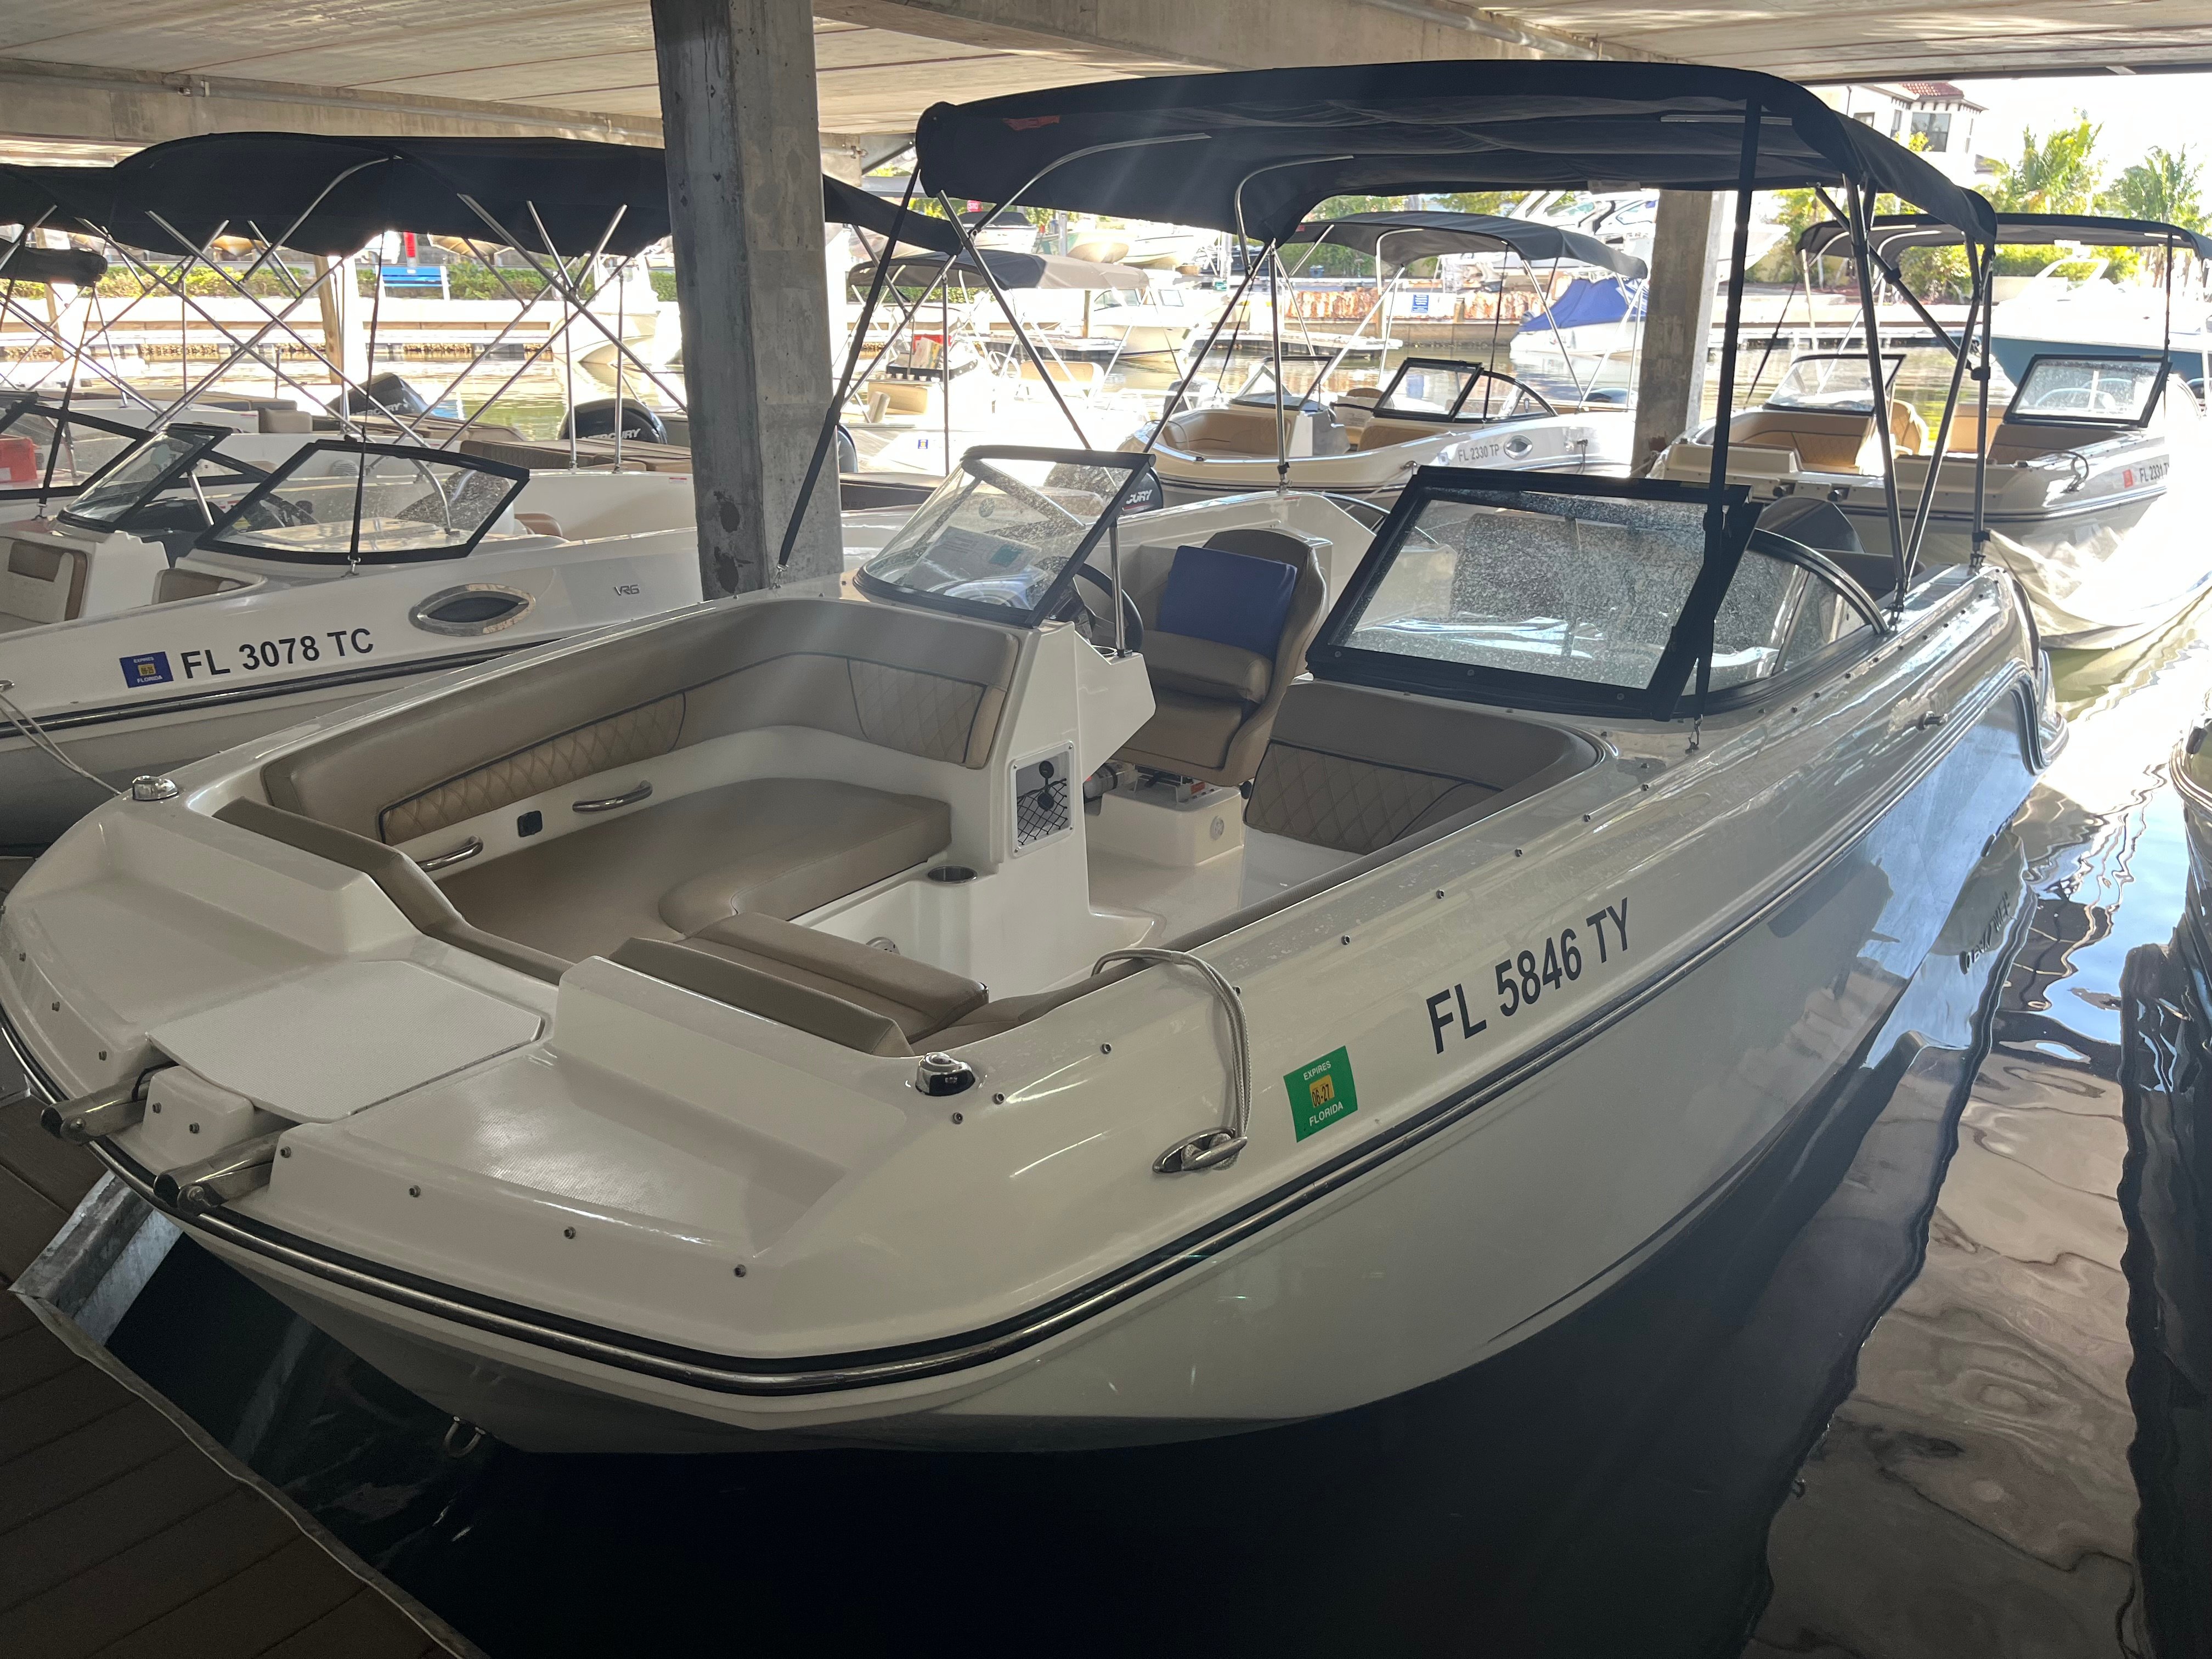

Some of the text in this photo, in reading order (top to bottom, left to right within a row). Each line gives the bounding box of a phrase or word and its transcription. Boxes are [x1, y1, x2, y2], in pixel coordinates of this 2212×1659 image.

[1458, 449, 1469, 462] FL
[1470, 445, 1488, 460] 2330
[1489, 443, 1499, 457] TP
[2140, 467, 2149, 483] FL
[2149, 464, 2164, 481] 2331
[180, 628, 374, 679] FL 3078 TC
[137, 675, 163, 684] FLORIDA
[1425, 896, 1628, 1054] FL 5846 TY
[1303, 1060, 1331, 1081] EXPIRES
[1312, 1084, 1330, 1107] 06-27
[1309, 1101, 1344, 1127] FLORIDA
